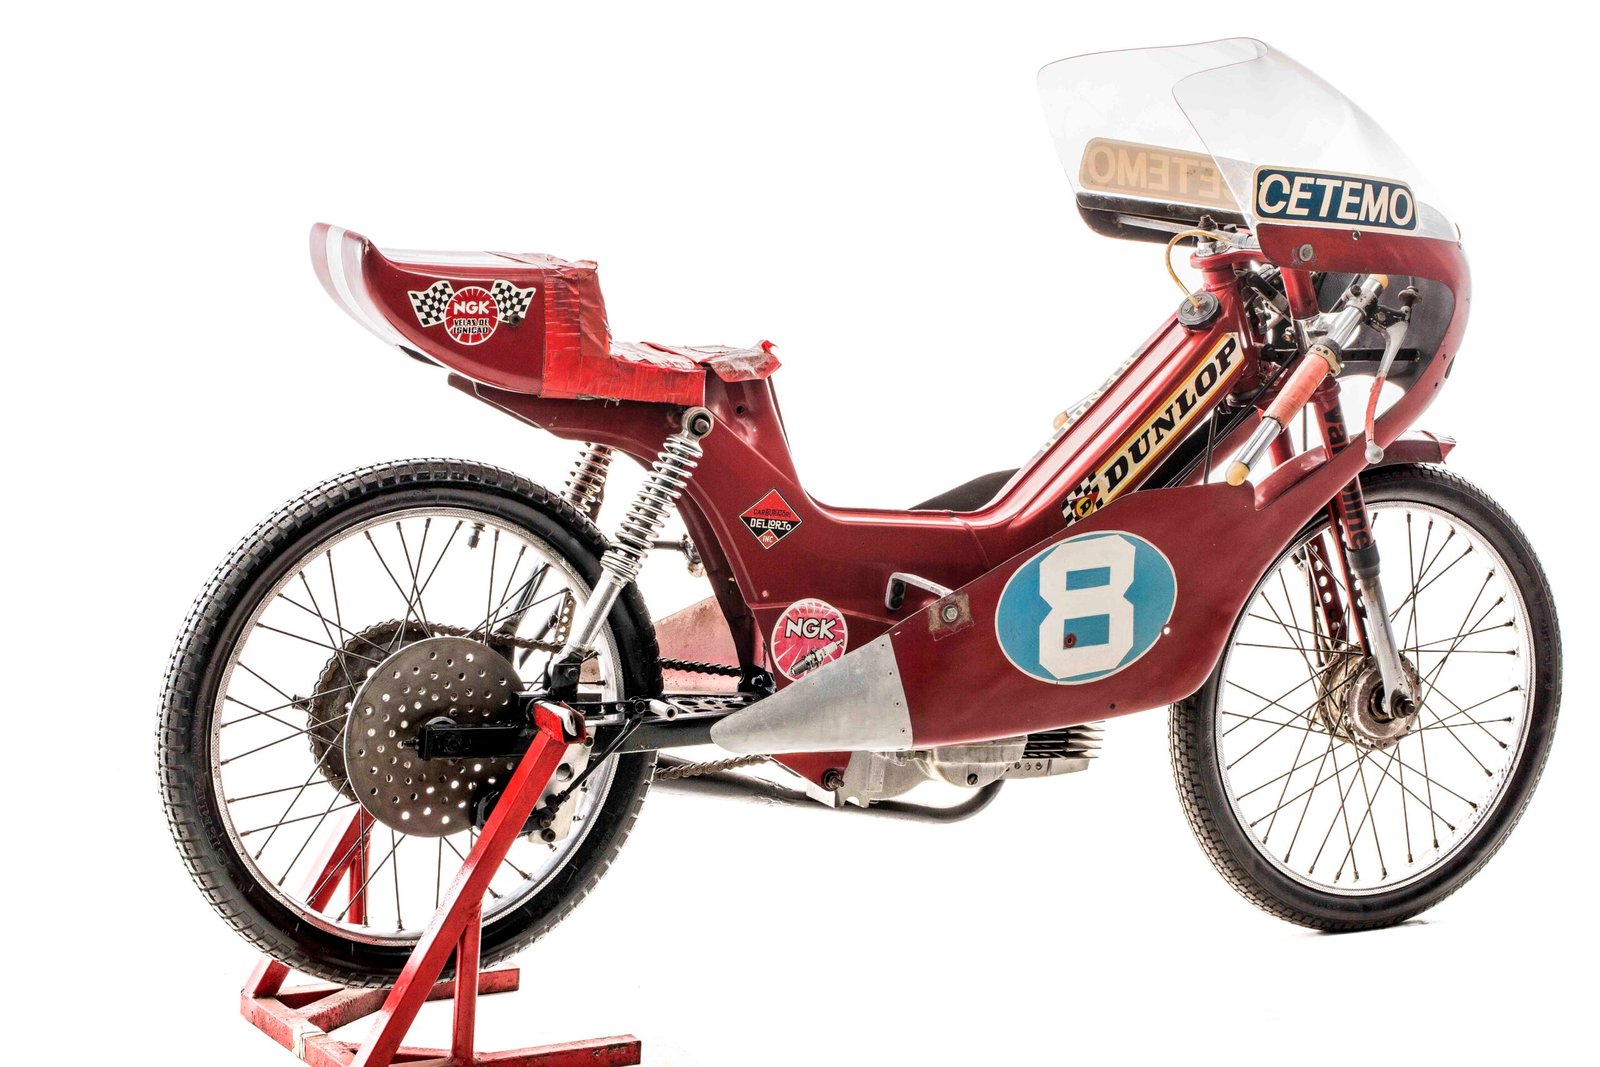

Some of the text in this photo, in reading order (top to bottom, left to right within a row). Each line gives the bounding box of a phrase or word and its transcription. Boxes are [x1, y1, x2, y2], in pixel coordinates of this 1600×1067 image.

[1257, 173, 1414, 227] CETEMO
[453, 300, 490, 315] NGK
[1104, 336, 1236, 493] DUNLOP
[750, 518, 792, 531] DELLORTO
[762, 535, 774, 543] INC
[1039, 534, 1136, 680] 8
[784, 617, 837, 641] NGK
